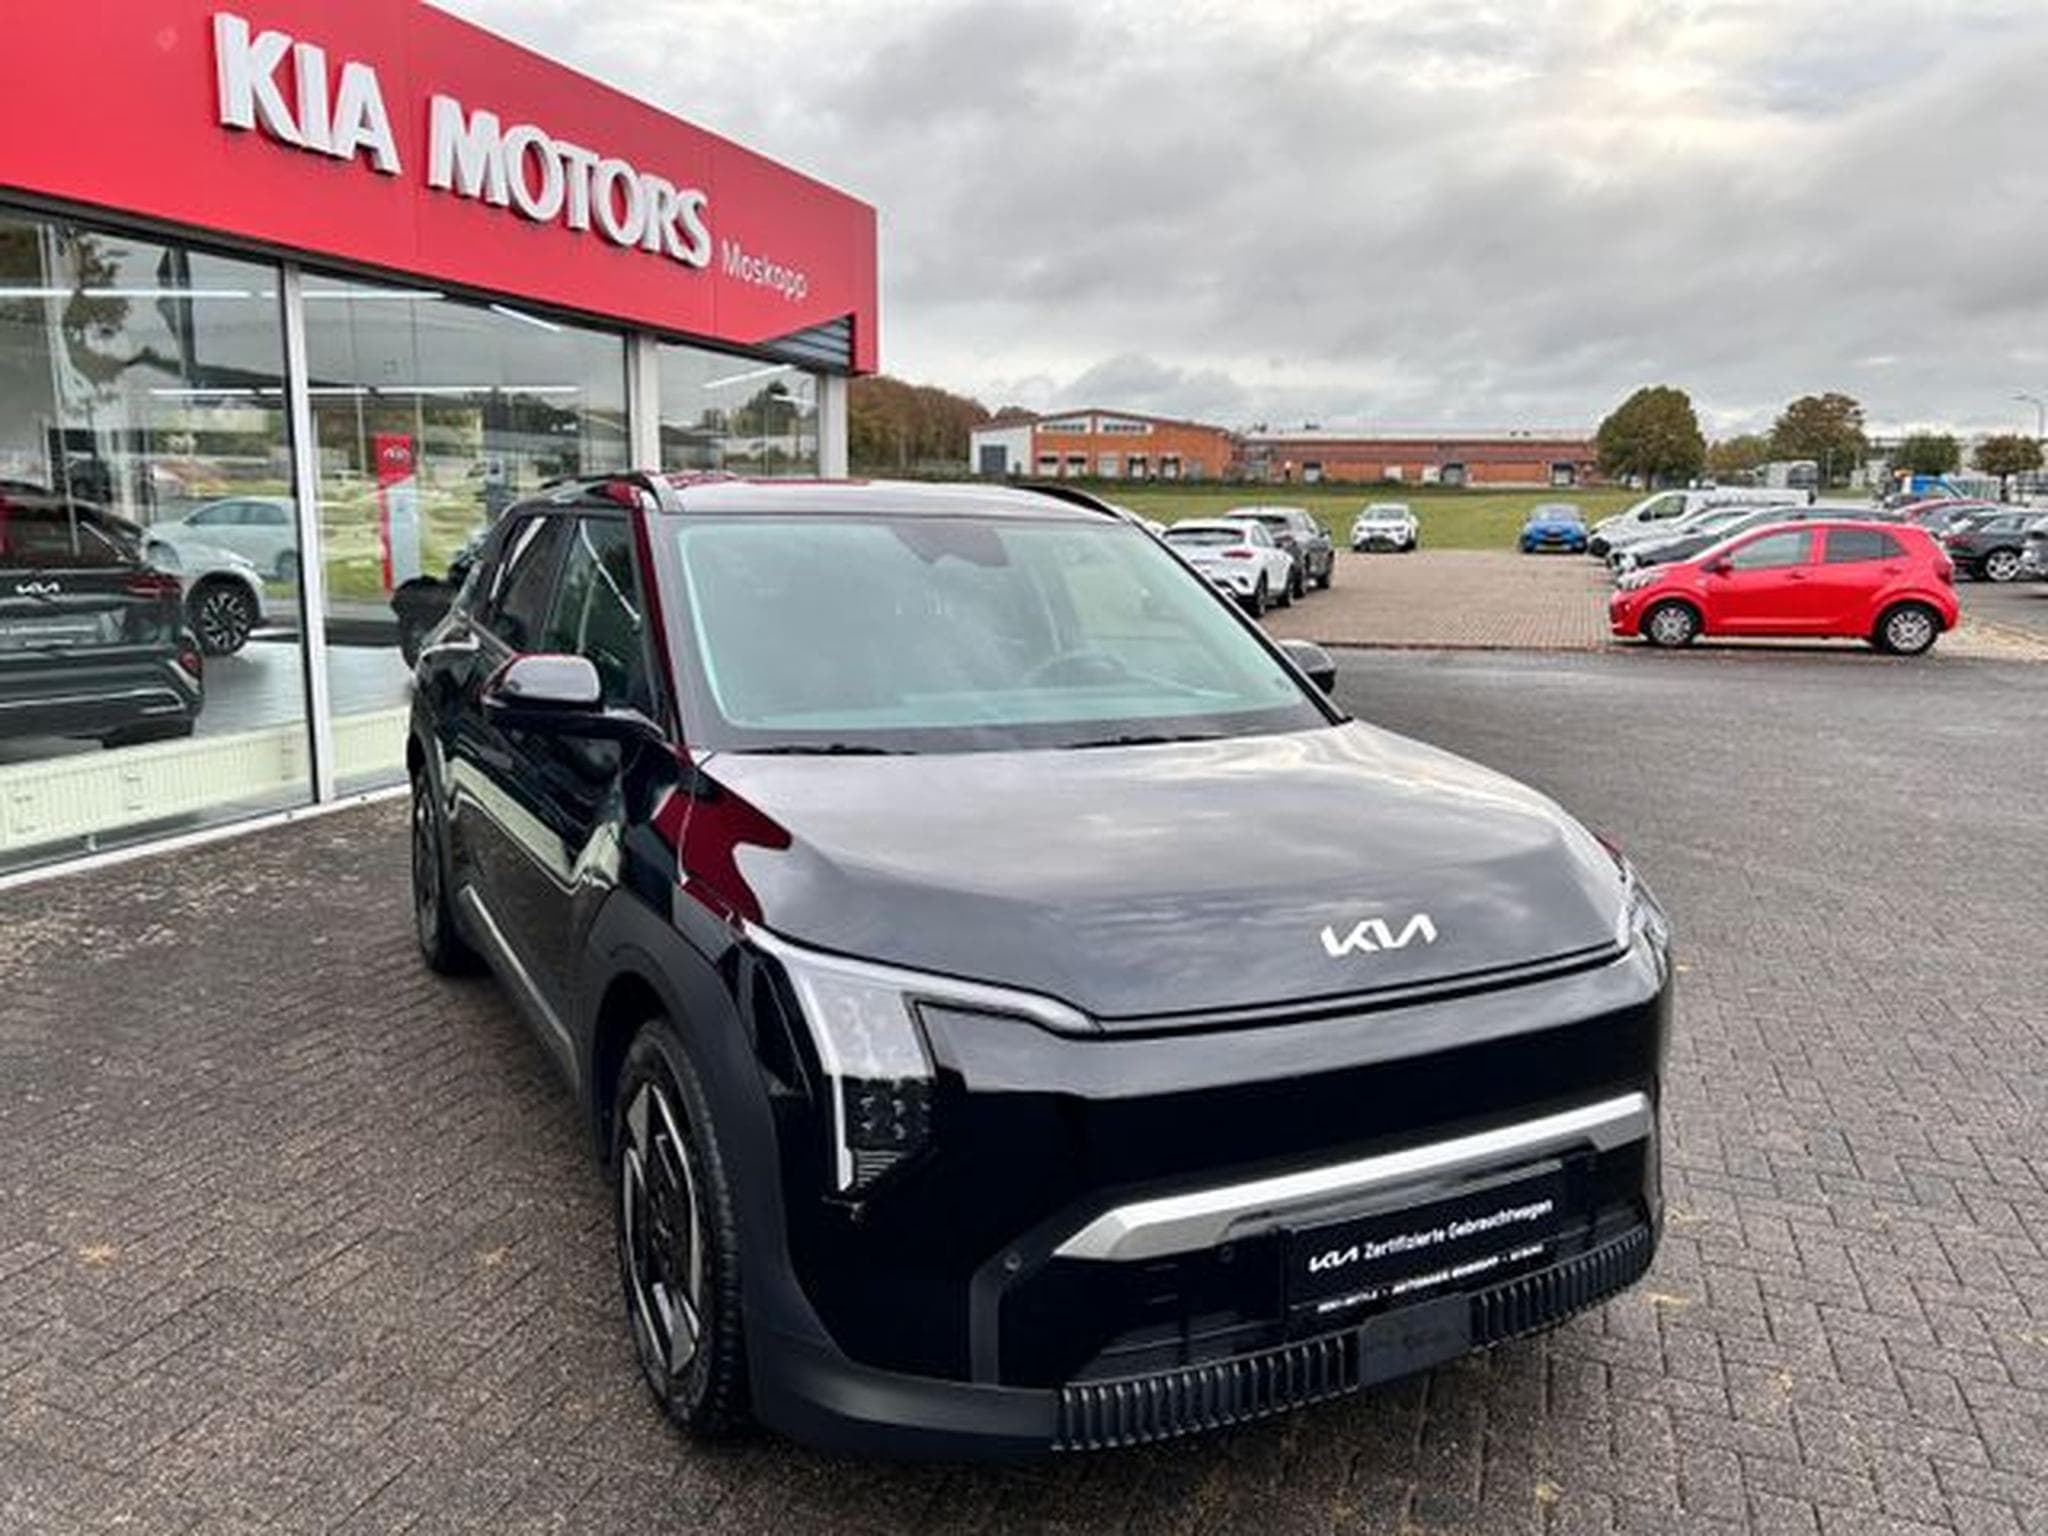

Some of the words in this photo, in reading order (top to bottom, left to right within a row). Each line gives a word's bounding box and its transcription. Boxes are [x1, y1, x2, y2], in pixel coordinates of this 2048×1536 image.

[213, 12, 401, 175] KIA
[428, 94, 712, 269] MOTORS
[721, 237, 808, 301] Moskopp
[1320, 913, 1438, 957] KIA
[1308, 1245, 1359, 1272] KIA
[1448, 1199, 1553, 1239] Gebrauchtwagen
